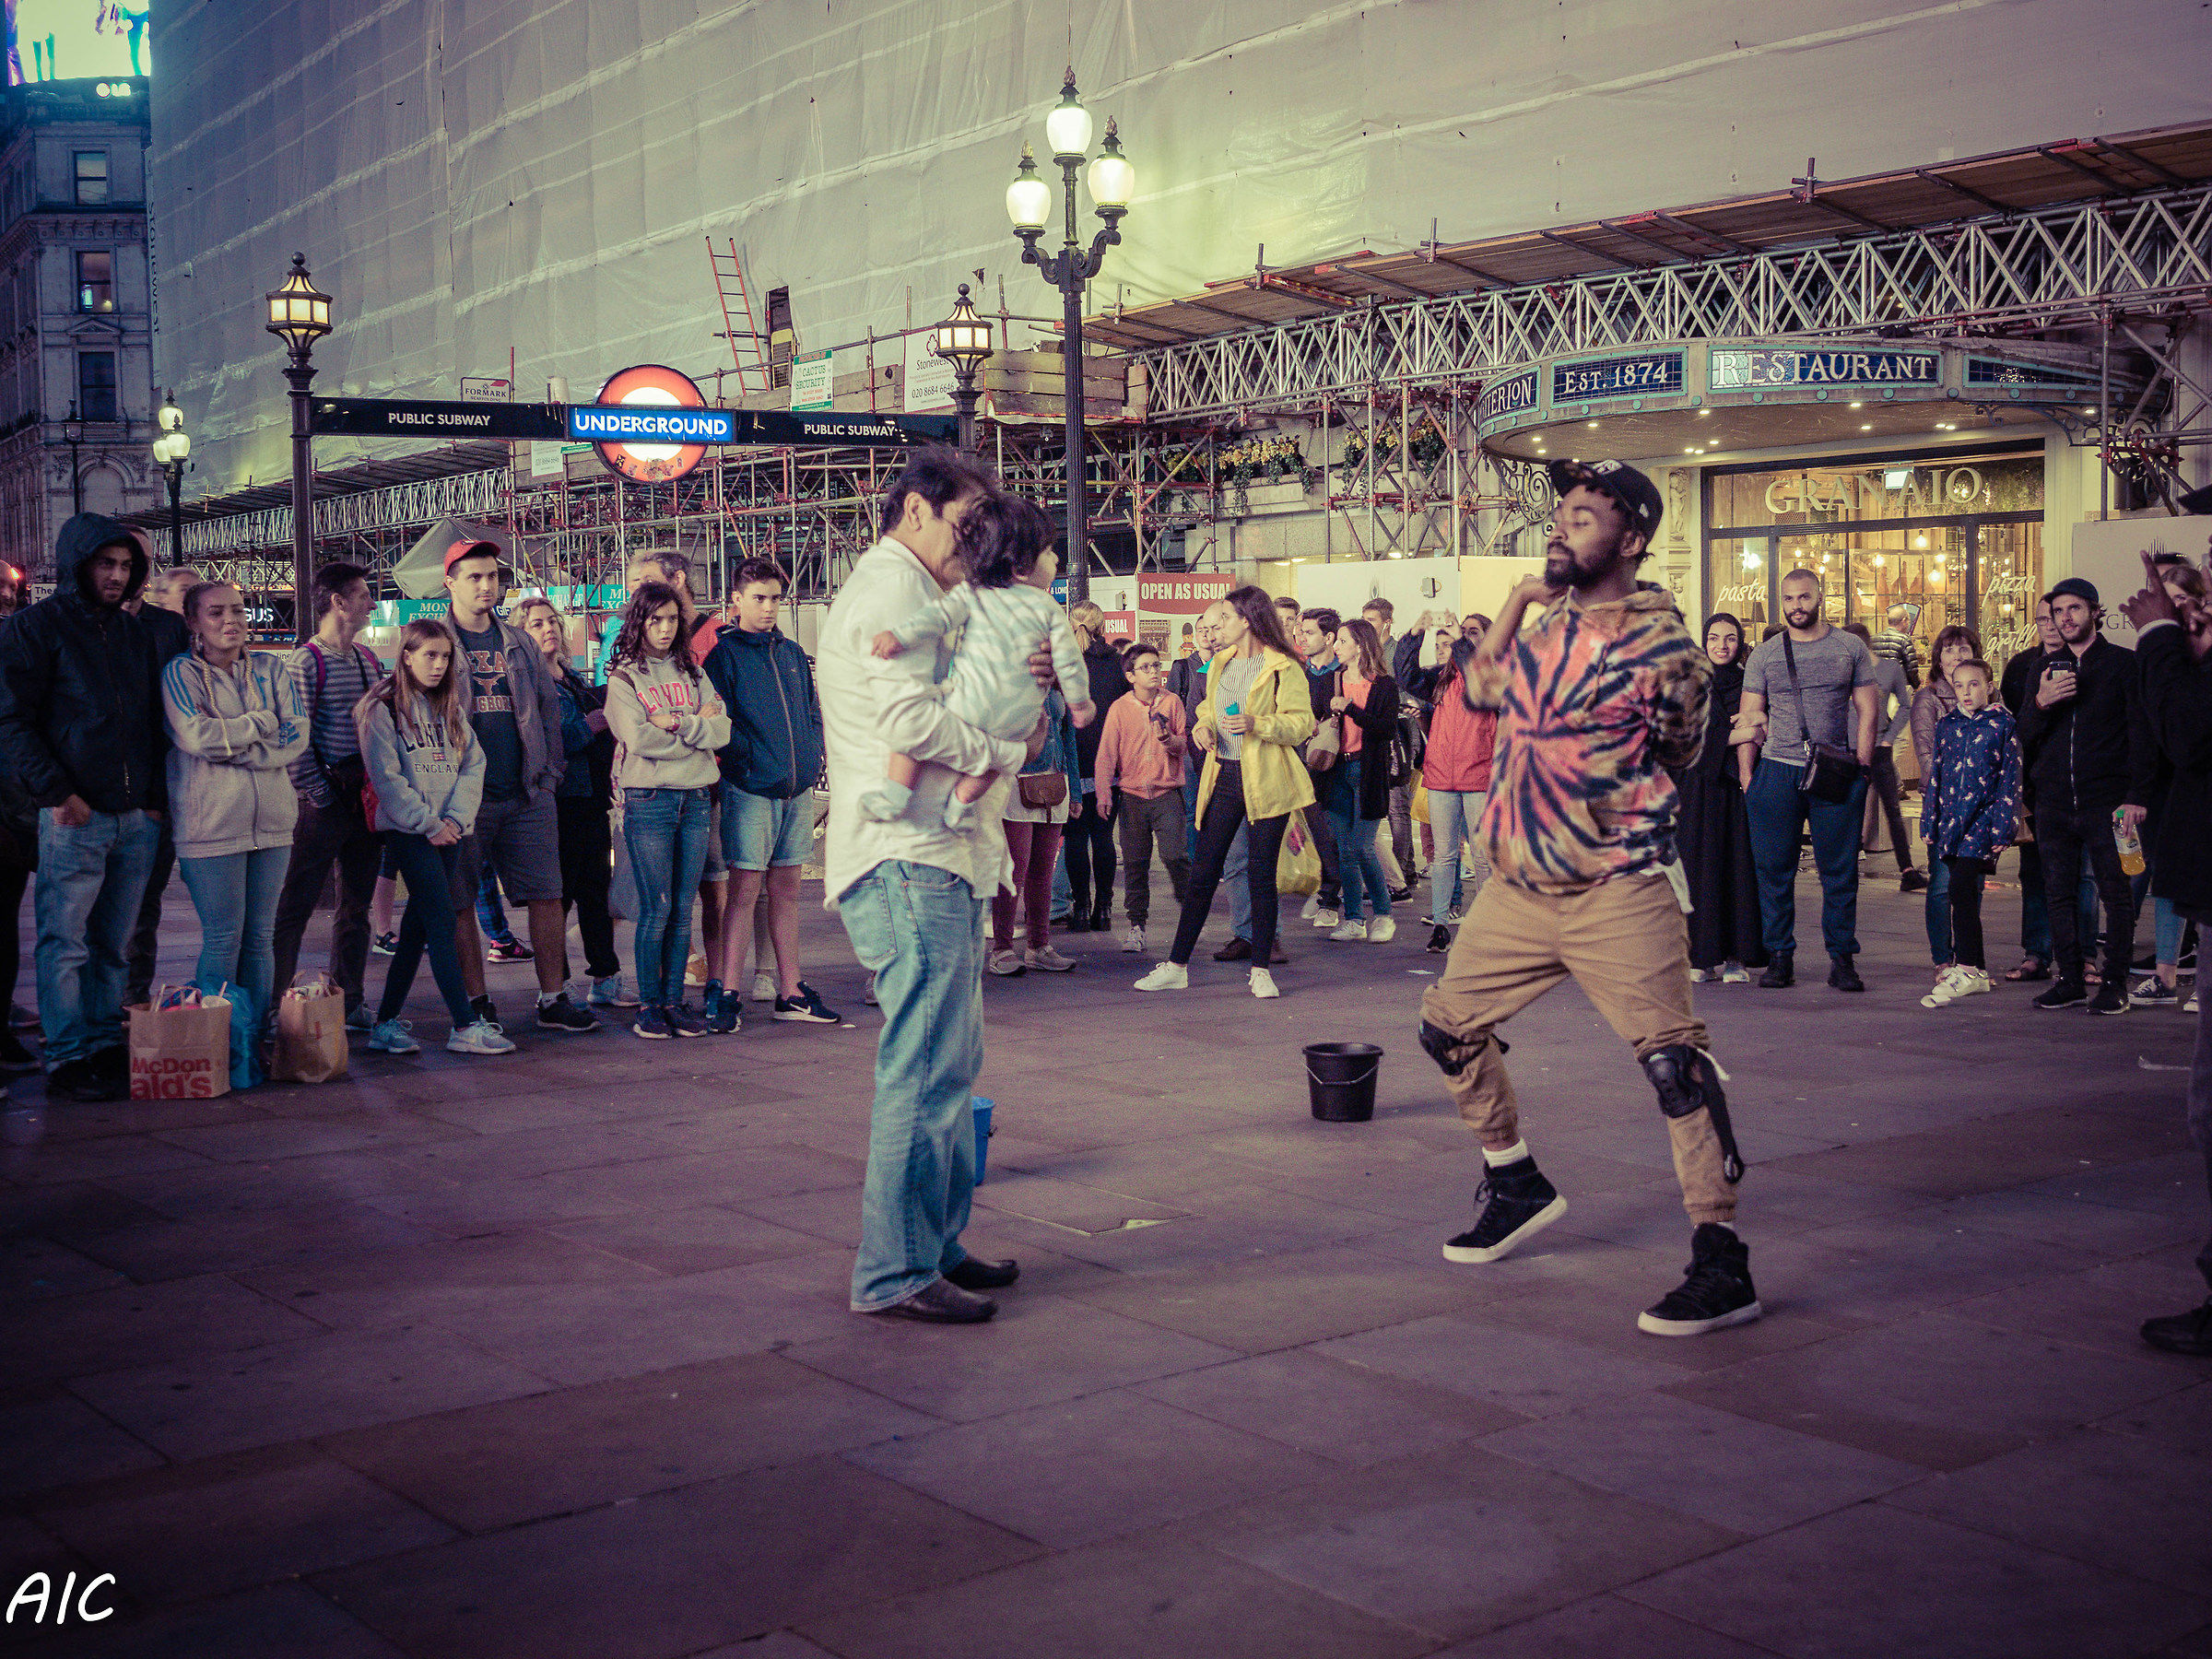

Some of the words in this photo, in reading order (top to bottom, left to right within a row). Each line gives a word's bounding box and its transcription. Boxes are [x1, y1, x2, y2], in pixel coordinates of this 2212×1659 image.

[803, 364, 827, 377] CACTUS
[1614, 361, 1668, 388] 1874
[1715, 353, 1932, 385] RESTAURANT
[795, 376, 826, 390] SECURITY
[465, 387, 507, 398] FORMARK
[912, 387, 923, 399] 020
[388, 413, 434, 425] PUBLIC
[437, 414, 491, 426] SUBWAY
[575, 414, 728, 436] UNDERGROUND
[804, 424, 845, 435] PUBLIC
[847, 425, 896, 436] SUBWAY
[1764, 466, 1983, 514] GRANAIO
[34, 586, 53, 594] The
[1140, 582, 1173, 600] OPEN
[1174, 582, 1192, 600] AS
[1712, 577, 1767, 615] pasta
[1982, 575, 2035, 608] pizza
[242, 607, 275, 623] GUS
[1105, 618, 1128, 633] USUAL
[1983, 623, 2038, 662] grill
[131, 1073, 213, 1100] ald's
